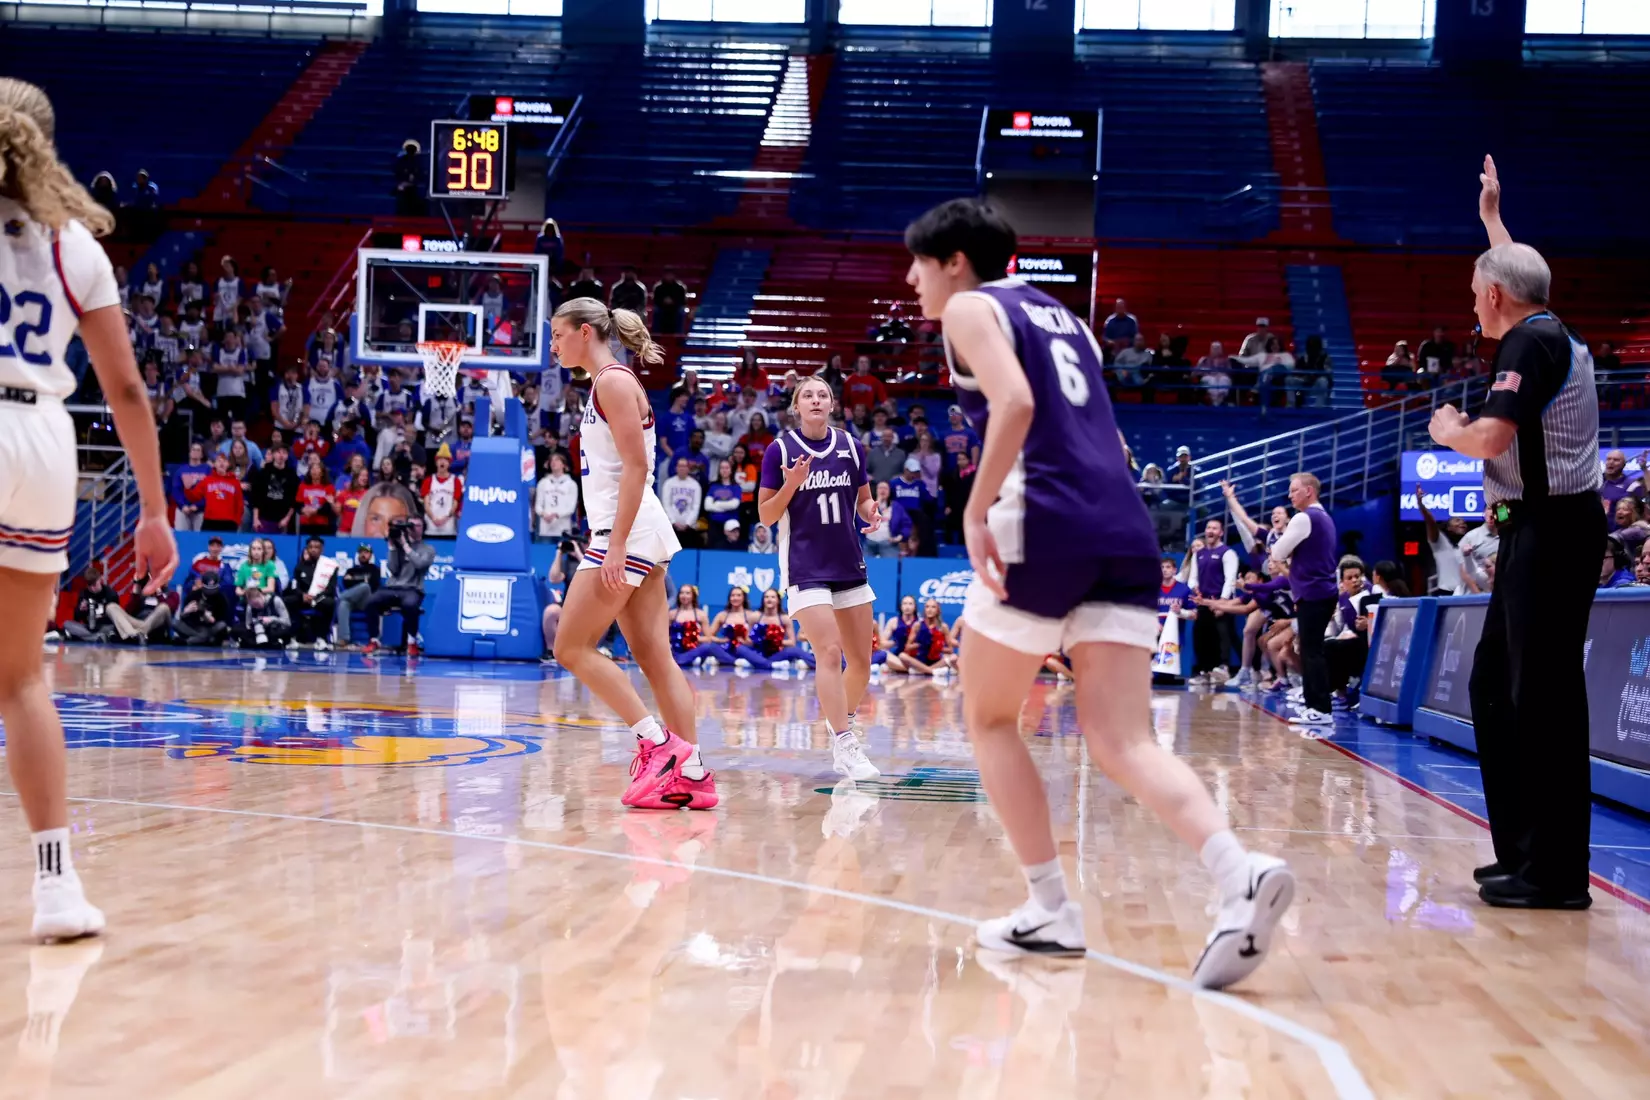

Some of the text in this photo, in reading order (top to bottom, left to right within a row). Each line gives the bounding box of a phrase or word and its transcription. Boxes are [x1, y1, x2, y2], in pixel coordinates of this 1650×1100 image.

[1471, 0, 1494, 16] 13
[514, 102, 552, 114] TOYOTA
[1032, 116, 1071, 127] TOYOTA
[453, 128, 499, 152] 6:48
[447, 151, 492, 190] 30
[1018, 258, 1063, 270] TOYOTA
[1050, 338, 1090, 407] 6
[799, 469, 851, 491] Wildcats
[817, 492, 841, 524] 11
[1400, 492, 1477, 512] KASAS 6
[466, 591, 505, 599] SHELTER
